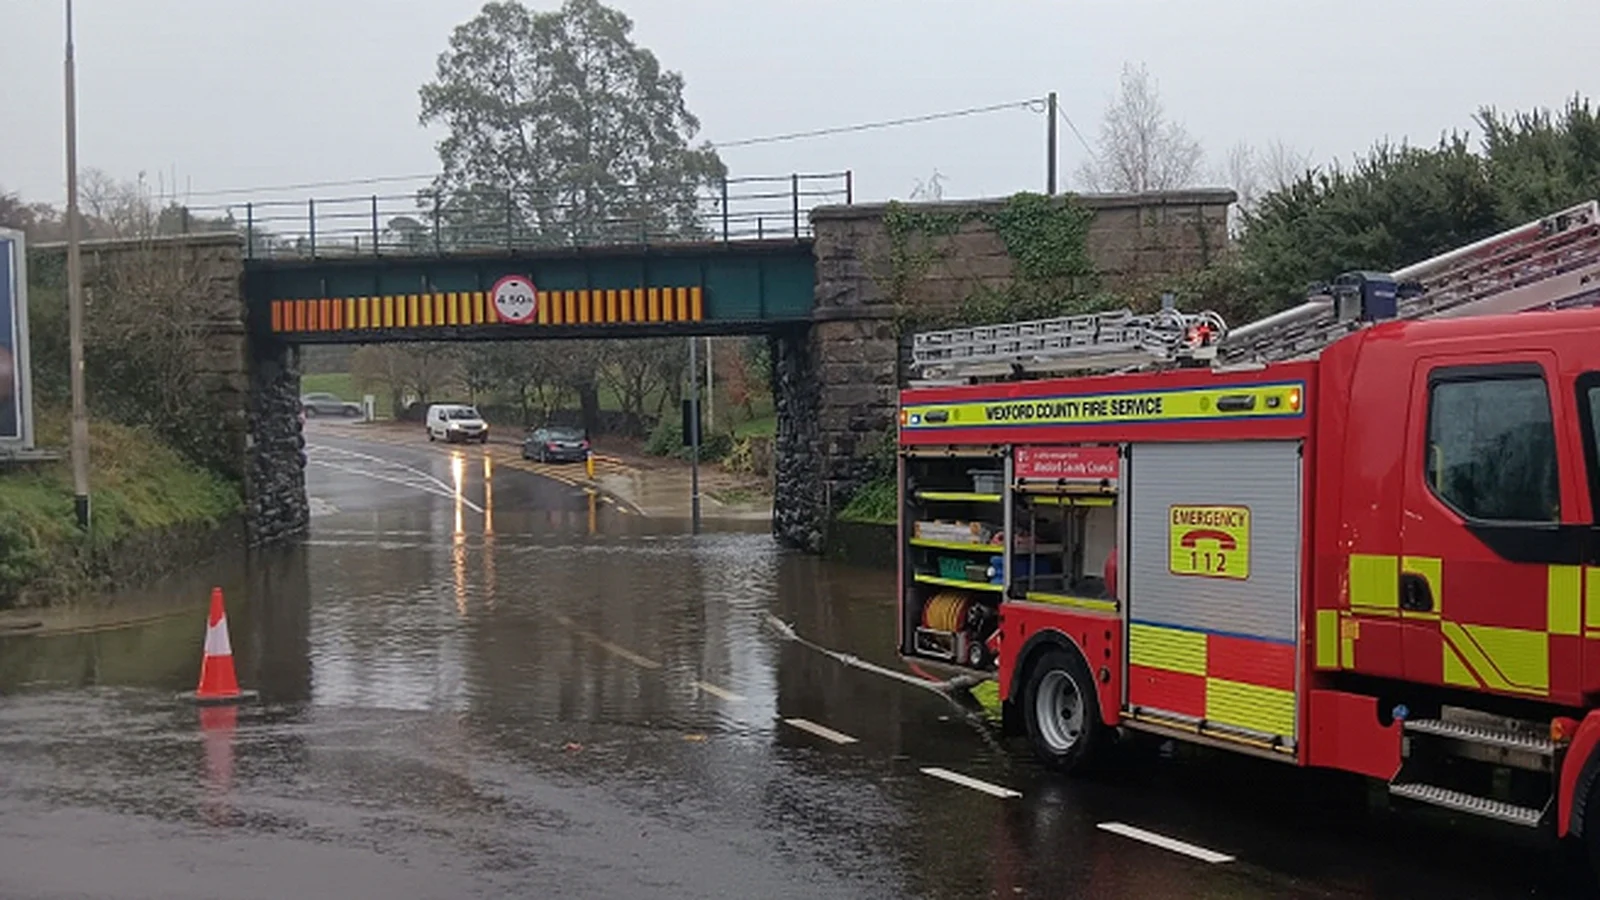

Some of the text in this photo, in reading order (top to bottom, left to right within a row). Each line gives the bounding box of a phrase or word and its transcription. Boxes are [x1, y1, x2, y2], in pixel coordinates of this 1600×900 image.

[985, 397, 1163, 421] WEXFORD COUNTY FIRE SERVICE
[1173, 509, 1246, 527] EMERGENCY
[1190, 551, 1226, 572] 112
